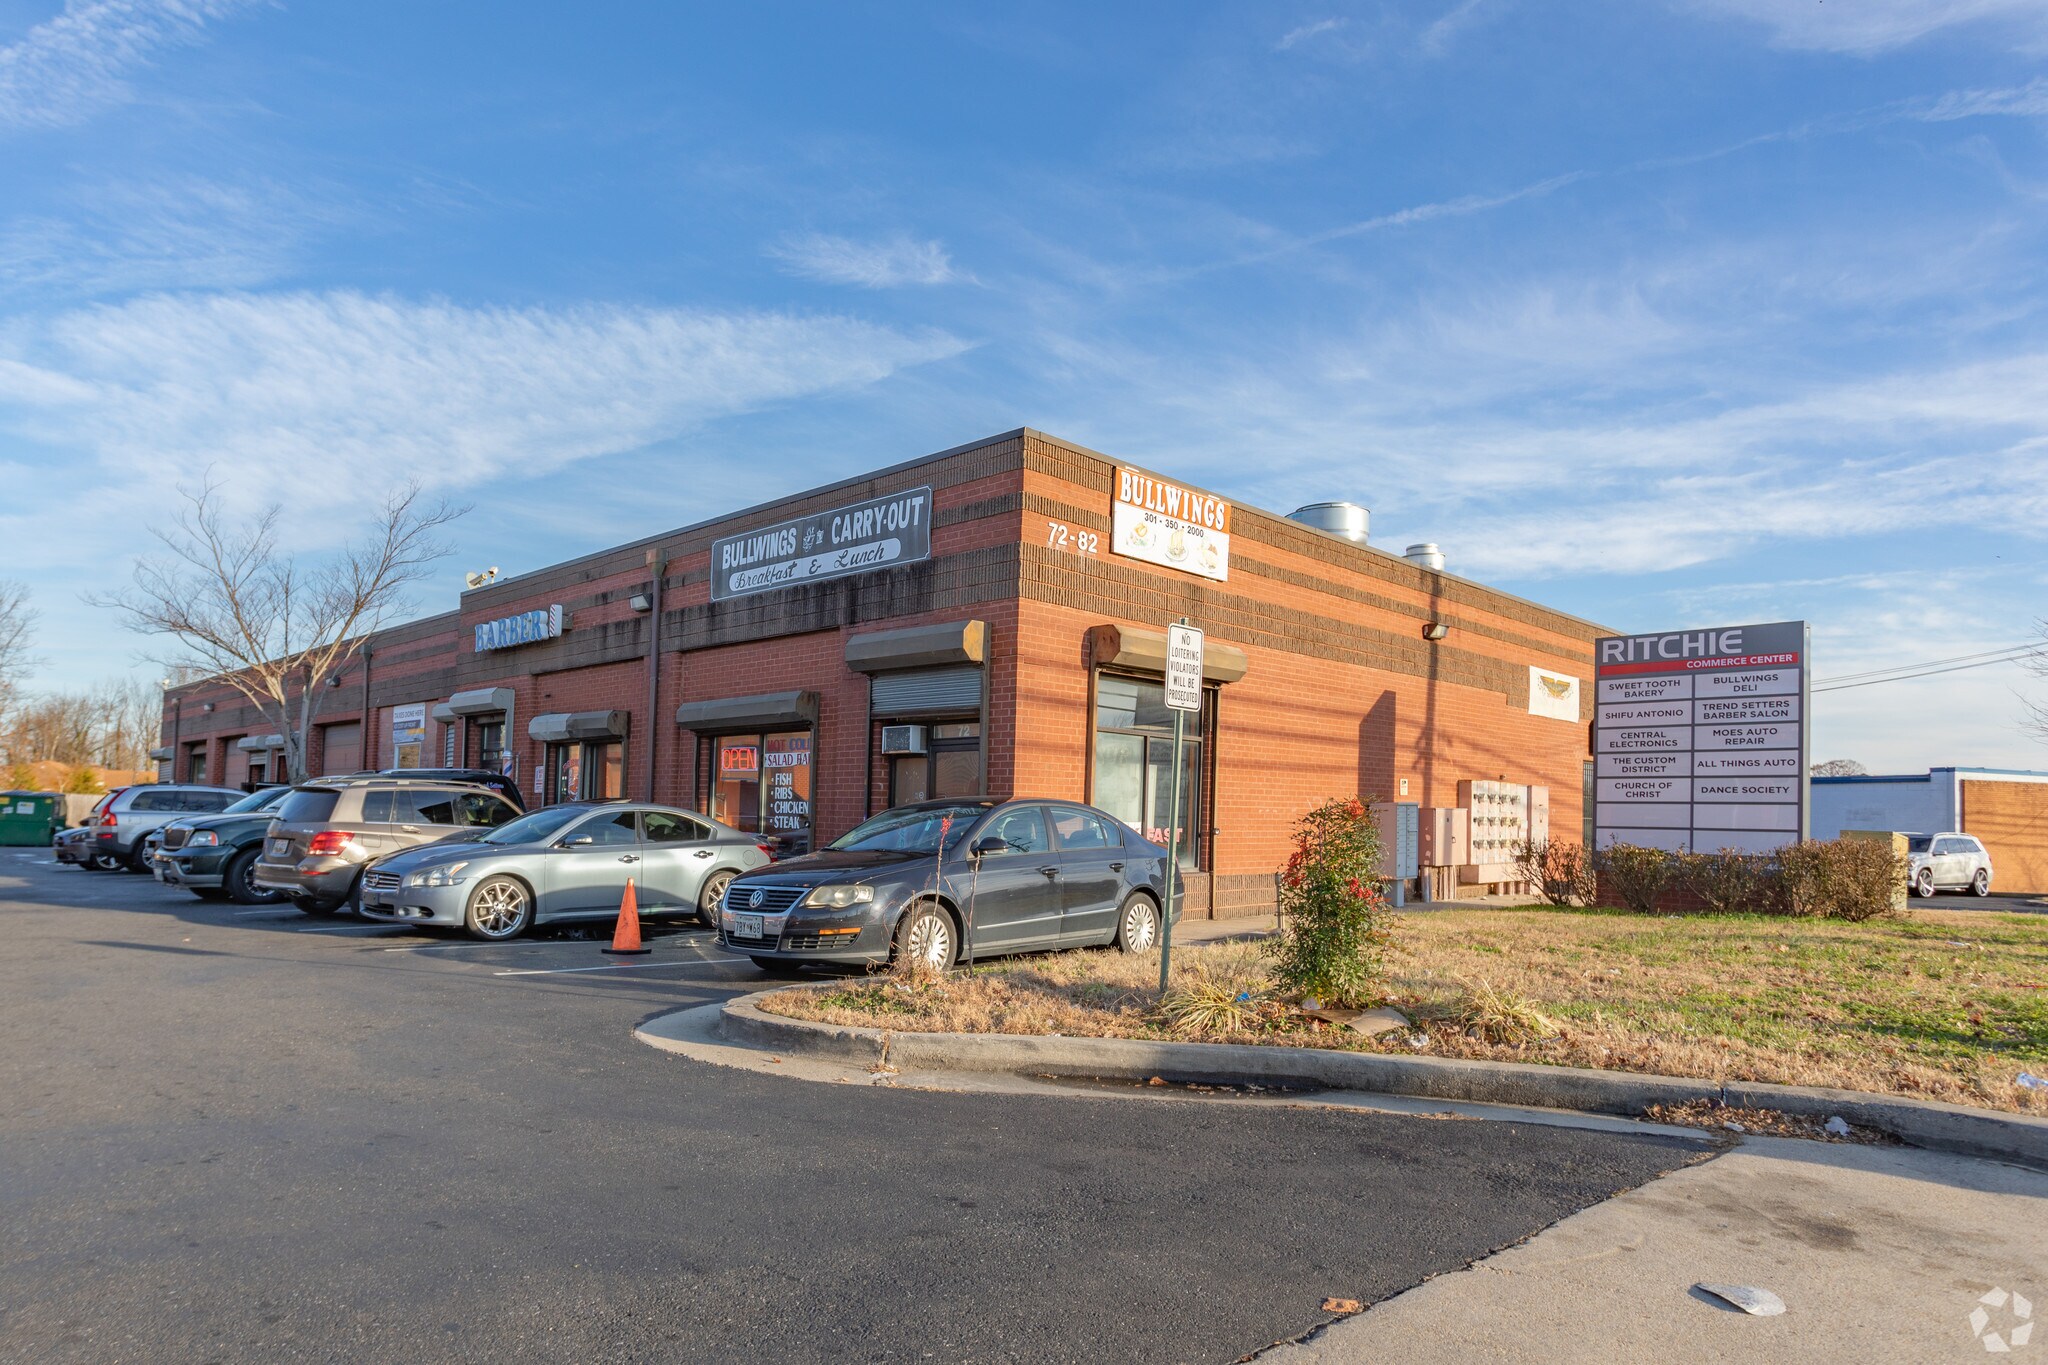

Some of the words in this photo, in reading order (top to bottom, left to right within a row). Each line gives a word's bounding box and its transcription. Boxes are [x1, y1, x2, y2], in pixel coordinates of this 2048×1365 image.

[1120, 471, 1225, 530] BULLWINGS
[722, 527, 797, 570] BULLWINGS
[734, 561, 798, 589] Breakfast
[808, 559, 821, 575] &
[834, 542, 885, 568] Lunch
[475, 610, 547, 653] BARBER
[1181, 634, 1191, 646] NO
[1602, 630, 1742, 663] RITCHIE
[1171, 646, 1199, 661] LOITERING
[1686, 657, 1747, 668] COMMERCE
[1749, 654, 1793, 664] CENTER
[1170, 660, 1199, 676] VIOLATORS
[1173, 675, 1186, 688] WILL
[1187, 677, 1195, 689] BE
[1713, 673, 1779, 684] BULLWINGS
[1609, 681, 1642, 691] SWEET
[1645, 679, 1680, 688] TOOTH
[1733, 684, 1758, 692] DELI
[1169, 688, 1198, 703] PROSECUTED
[1624, 689, 1664, 698] BAKERY
[1702, 702, 1738, 711] TREND
[1741, 700, 1790, 709] SETTERS
[1605, 711, 1633, 720] SHIFU
[1636, 709, 1684, 718] ANTONIO
[1703, 711, 1747, 720] BARBER
[1750, 709, 1788, 718] SALON
[958, 725, 970, 737] 72
[1620, 731, 1667, 739] CENTRAL
[1712, 728, 1743, 737] MOES
[1746, 727, 1778, 736] AUTO
[789, 738, 811, 751] COL
[1609, 739, 1678, 748] ELECTRONICS
[1725, 737, 1765, 745] REPAIR
[723, 748, 756, 769] OPEN
[767, 753, 794, 767] SALAD
[1612, 757, 1631, 765] THE
[1634, 756, 1676, 764] CUSTOM
[1697, 760, 1717, 768] ALL
[1720, 759, 1760, 768] THINGS
[1763, 758, 1796, 767] AUTO
[1621, 765, 1667, 773] DISTRICT
[775, 773, 793, 786] FISH
[1614, 782, 1655, 790] CHURCH
[1701, 786, 1738, 794] DANCE
[1741, 786, 1790, 794] SOCIETY
[774, 786, 793, 800] RIBS
[774, 801, 809, 814] CHICKEN
[774, 816, 800, 829] STEAK
